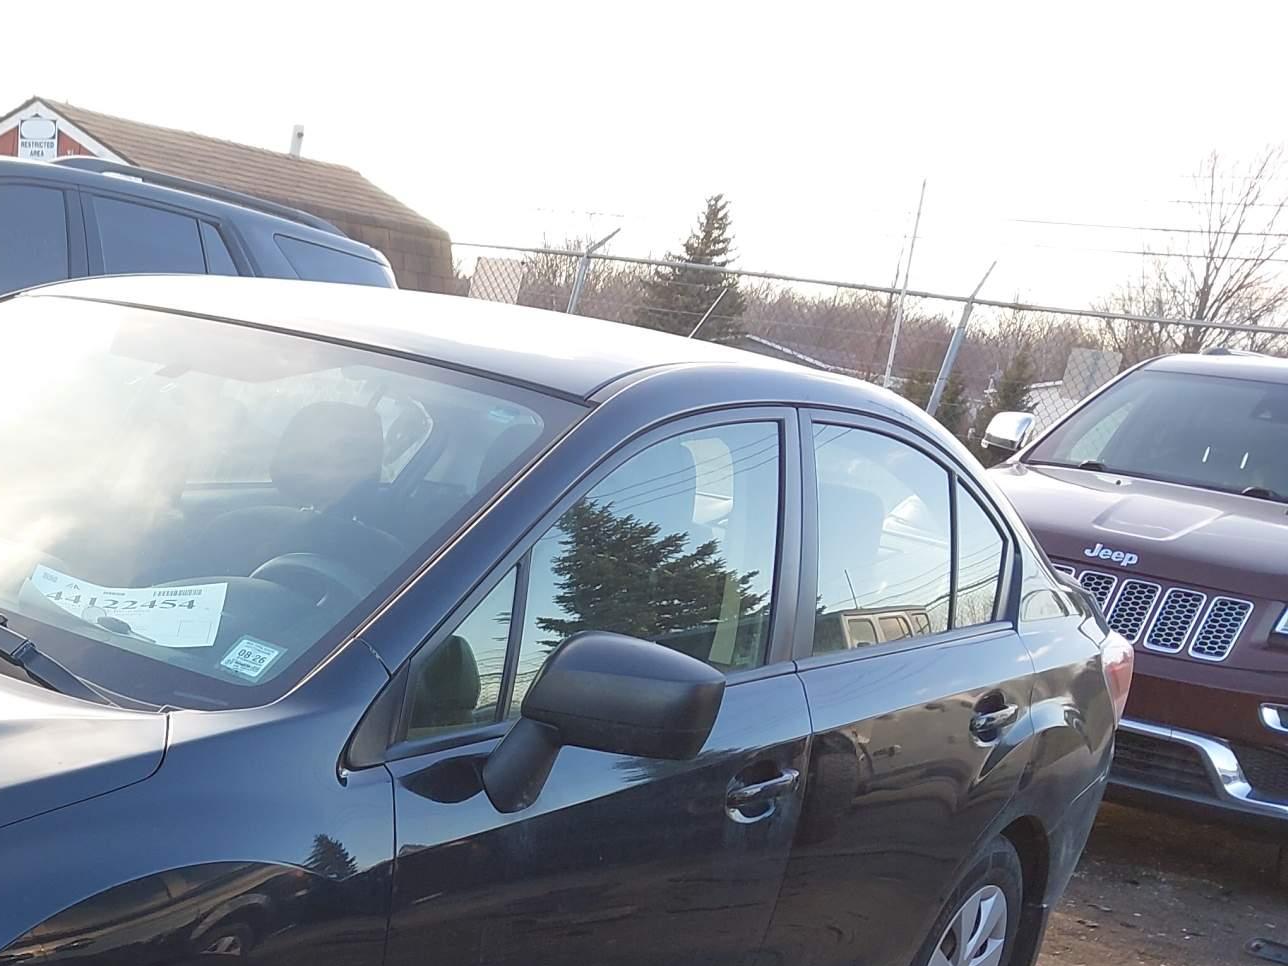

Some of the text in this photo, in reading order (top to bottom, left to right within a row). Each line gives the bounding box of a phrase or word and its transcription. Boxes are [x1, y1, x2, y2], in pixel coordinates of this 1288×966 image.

[21, 141, 55, 149] RESTRICTED
[1084, 543, 1138, 567] Jeep
[46, 591, 195, 610] 44122454
